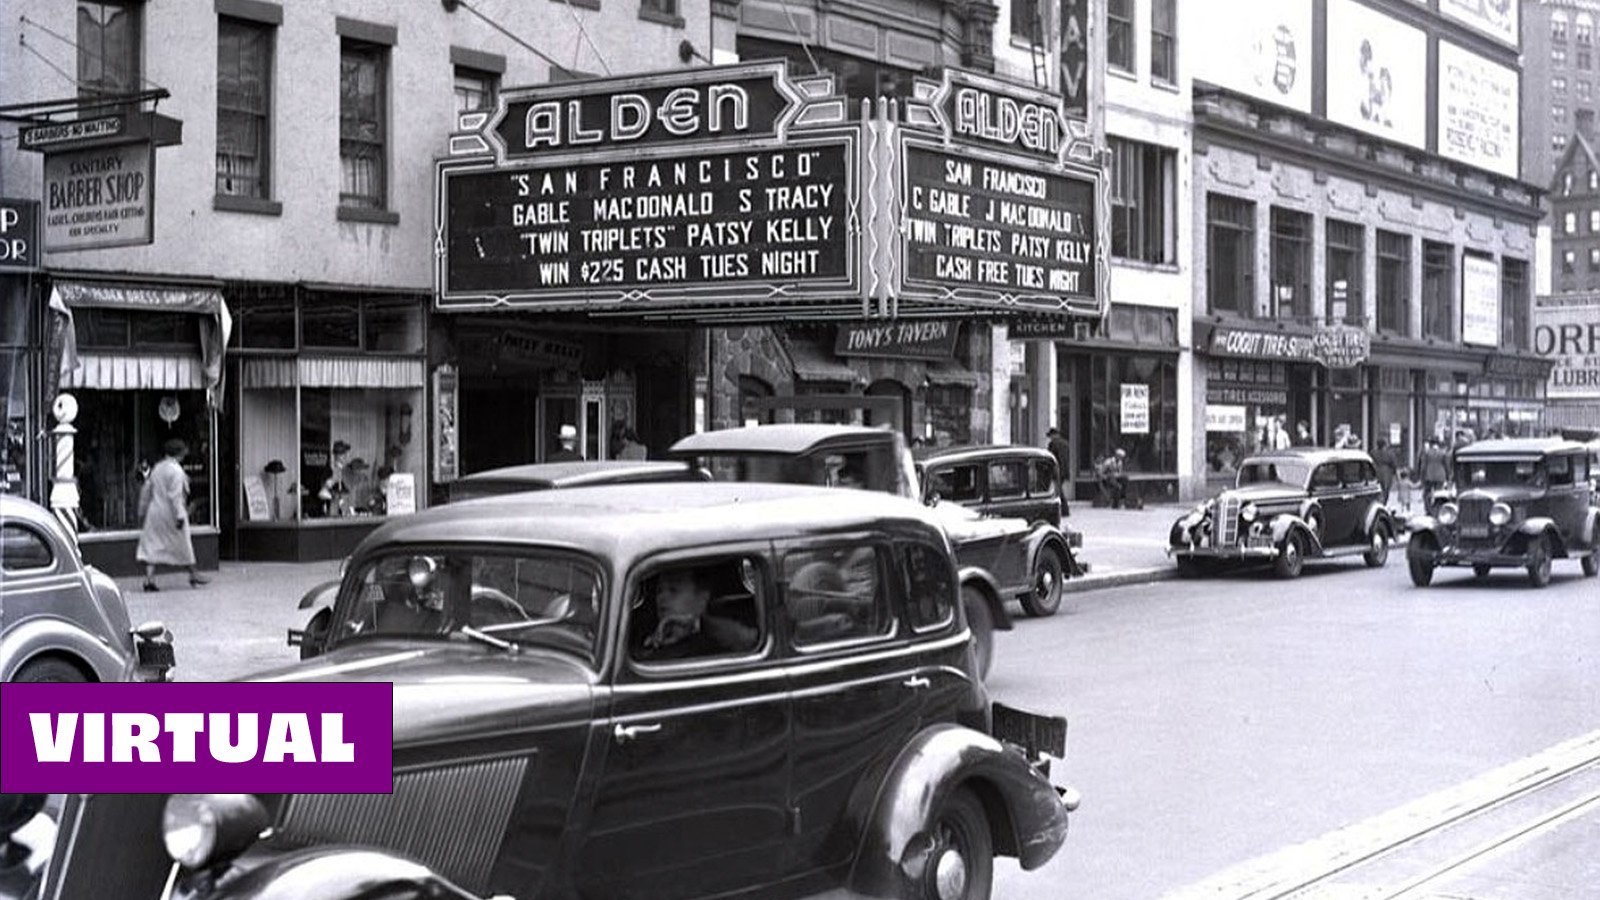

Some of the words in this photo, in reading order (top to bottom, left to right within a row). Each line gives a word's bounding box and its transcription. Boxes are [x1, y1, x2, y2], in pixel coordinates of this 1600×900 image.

[525, 83, 748, 148] ALDEN
[955, 87, 1060, 154] ALDEN
[70, 156, 124, 175] SANITARY
[945, 159, 972, 187] SAN
[983, 166, 1047, 200] FRANCISCO
[50, 175, 103, 211] BARBER
[106, 170, 145, 205] SHOP
[512, 201, 570, 226] GABLE
[739, 188, 752, 213] S
[765, 183, 834, 212] TRACY
[912, 186, 922, 211] C
[929, 188, 971, 218] GABLE
[985, 199, 995, 222] J
[687, 219, 753, 247] PATSY
[767, 215, 833, 244] KELLY
[943, 222, 1001, 252] TRIPLETS
[1011, 232, 1050, 259] PATSY
[1056, 239, 1091, 264] KELLY
[539, 260, 569, 286] WIN
[581, 257, 624, 284] $225
[636, 255, 687, 281] CASH
[700, 253, 749, 279] TUES
[761, 250, 820, 276] NIGHT
[936, 254, 972, 281] CASH
[977, 259, 1009, 285] FREE
[1015, 263, 1044, 289] TUES
[1049, 268, 1080, 293] NIGHT
[896, 320, 948, 345] TAVERN
[1016, 322, 1066, 333] KITCHEN
